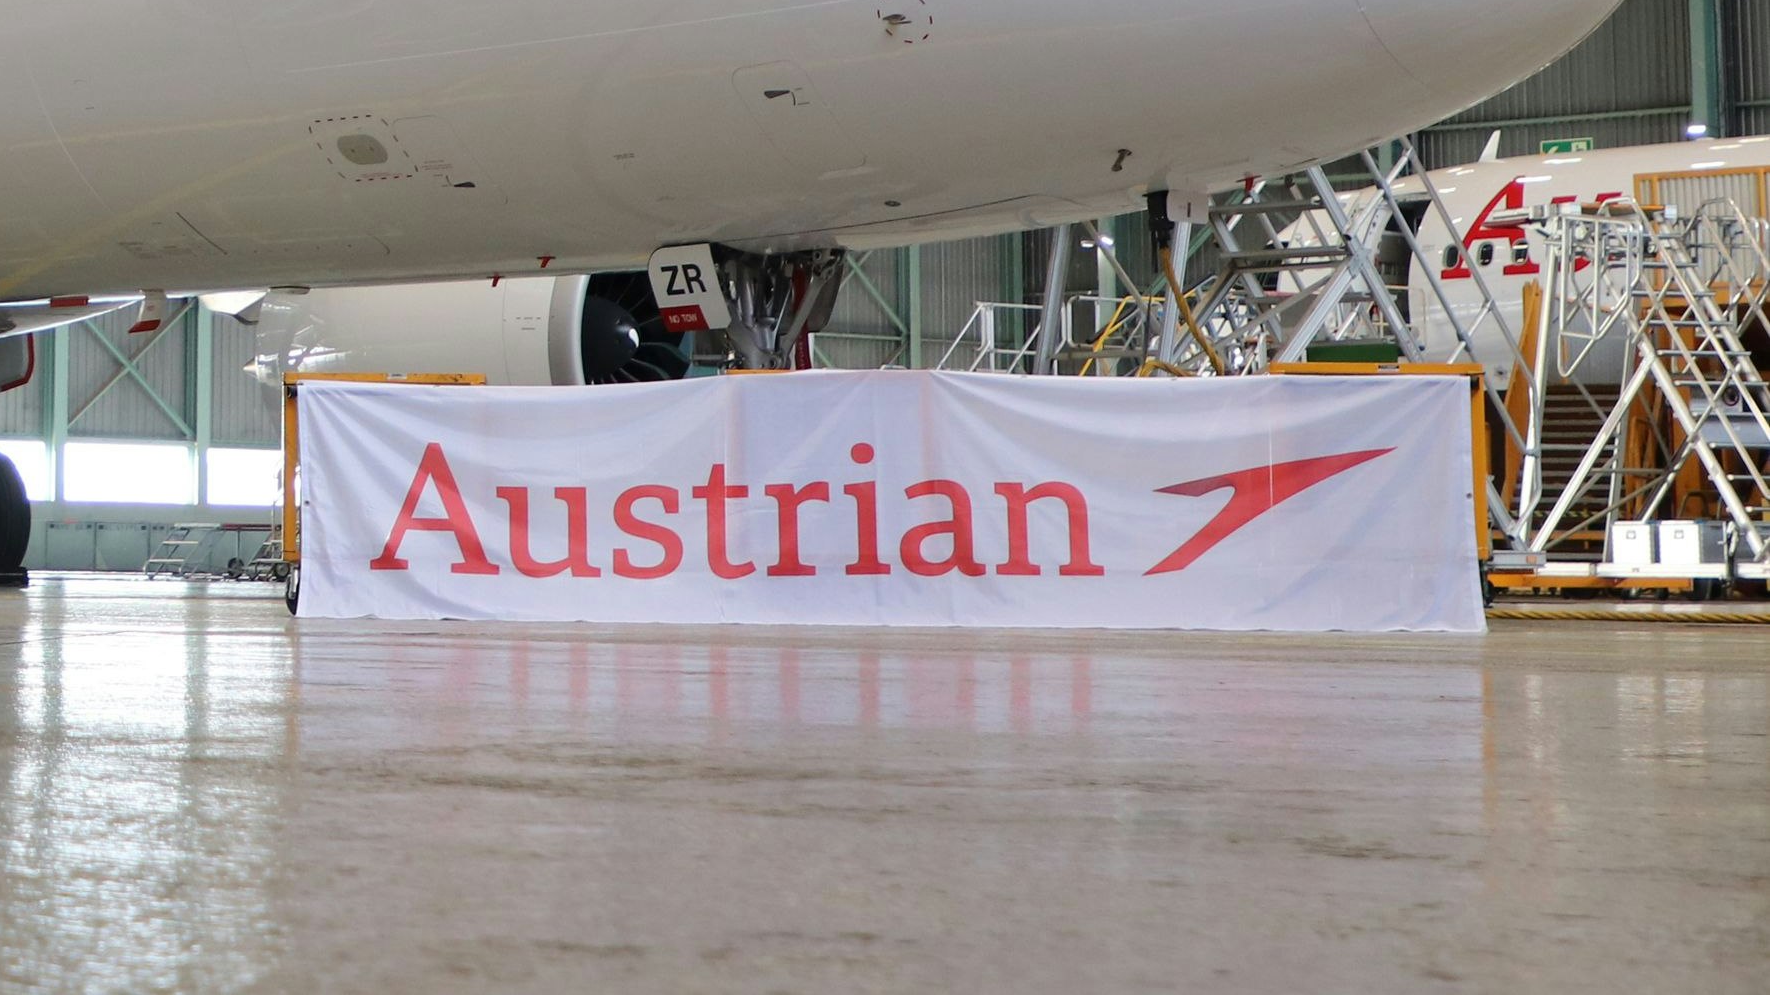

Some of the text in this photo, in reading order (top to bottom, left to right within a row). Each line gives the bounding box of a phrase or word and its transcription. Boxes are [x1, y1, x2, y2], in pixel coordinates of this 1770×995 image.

[660, 263, 707, 296] ZR
[668, 312, 698, 324] NO TOW
[370, 442, 1105, 580] Austrian
